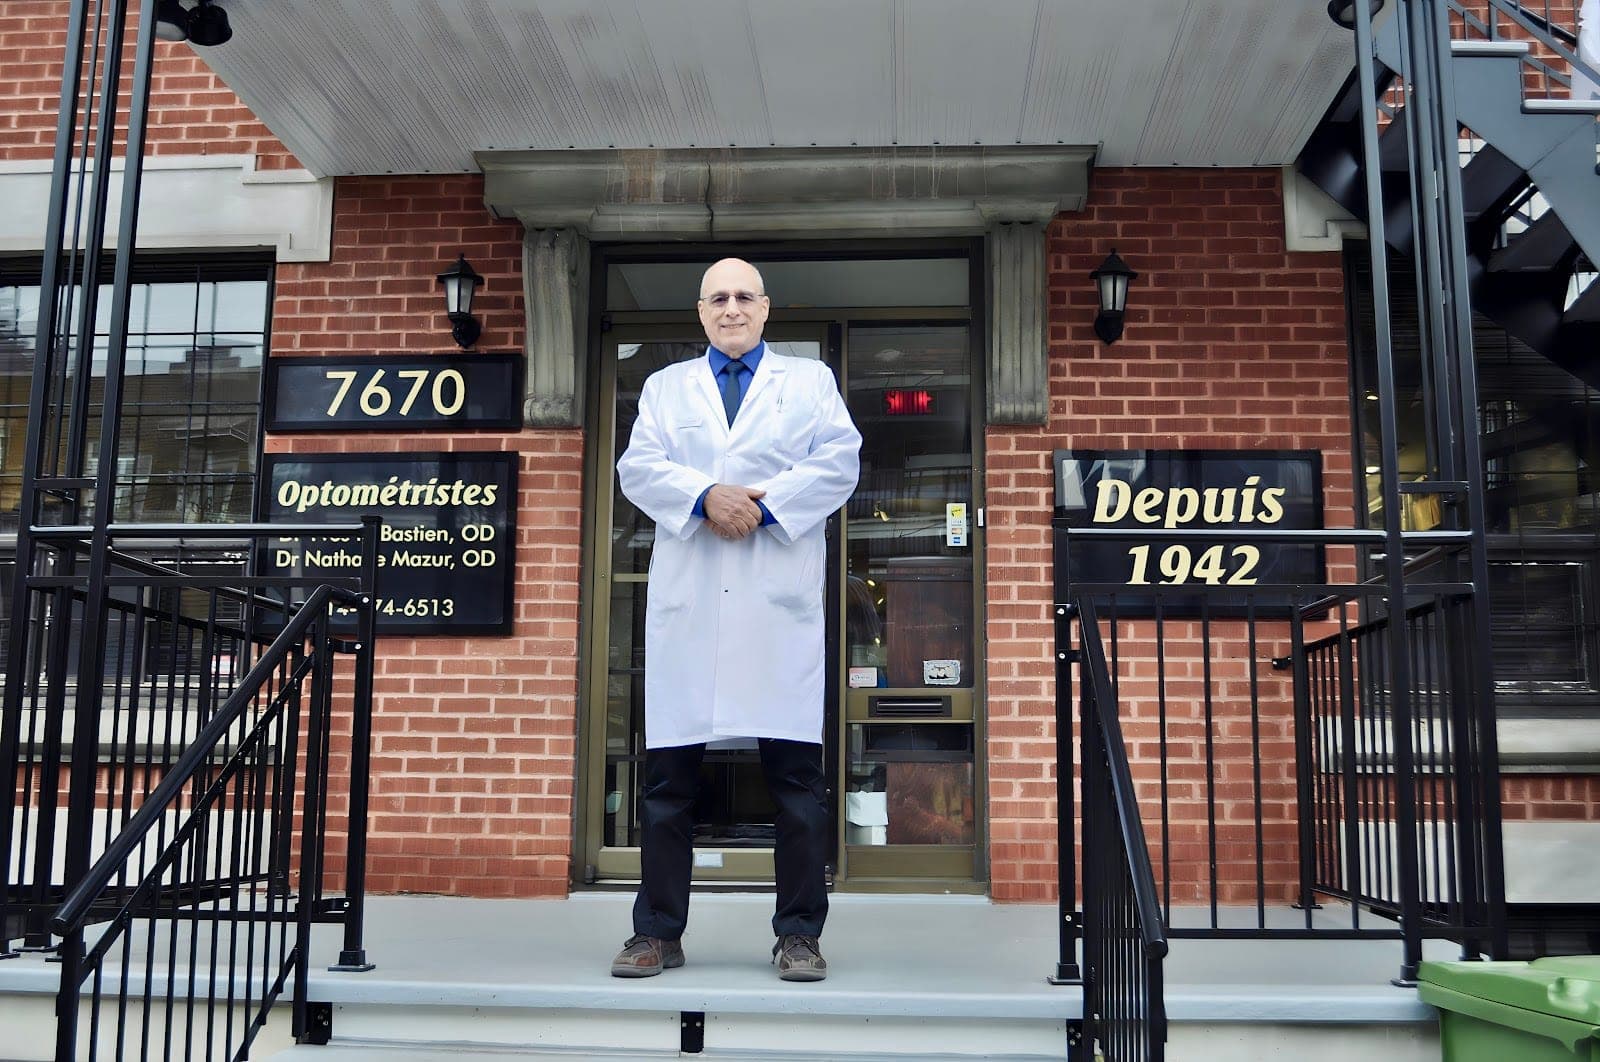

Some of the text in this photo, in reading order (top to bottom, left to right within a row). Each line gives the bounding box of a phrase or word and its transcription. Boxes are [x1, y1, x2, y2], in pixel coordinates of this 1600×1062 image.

[326, 368, 466, 417] 7670
[277, 476, 498, 513] Optométristes
[1092, 475, 1286, 529] Depuis
[380, 524, 495, 545] Bastien, OD
[276, 549, 300, 568] Dr
[391, 549, 456, 571] Mazur,
[462, 549, 496, 568] OD
[1125, 544, 1260, 585] 1942
